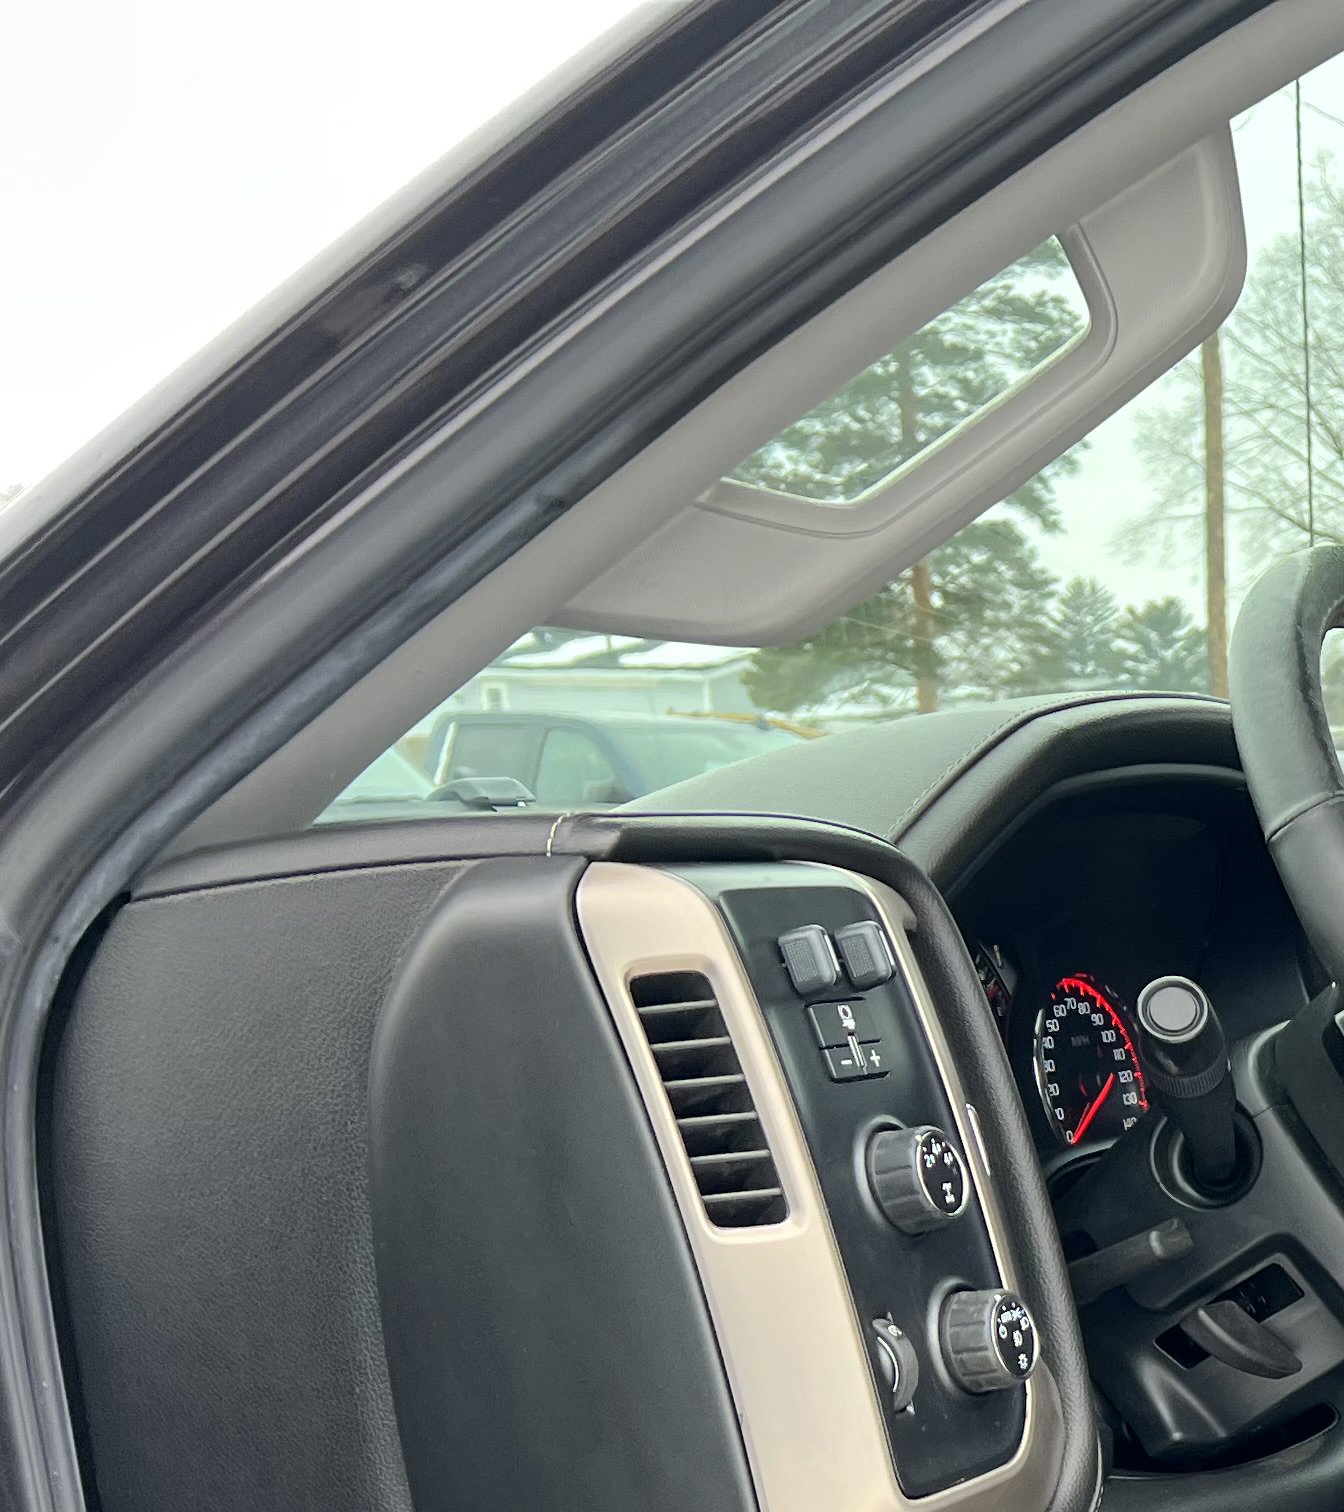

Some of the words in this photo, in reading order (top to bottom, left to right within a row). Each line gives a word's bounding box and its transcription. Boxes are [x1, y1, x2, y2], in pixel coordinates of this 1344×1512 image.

[1064, 997, 1077, 1010] 70
[1077, 1001, 1091, 1015] 80
[1053, 1004, 1067, 1018] 60
[1045, 1018, 1060, 1033] 50
[1090, 1013, 1104, 1026] 90
[1101, 1029, 1117, 1043] 100
[1112, 1048, 1126, 1061] 110
[1118, 1070, 1133, 1083] 120
[1122, 1092, 1138, 1106] 130
